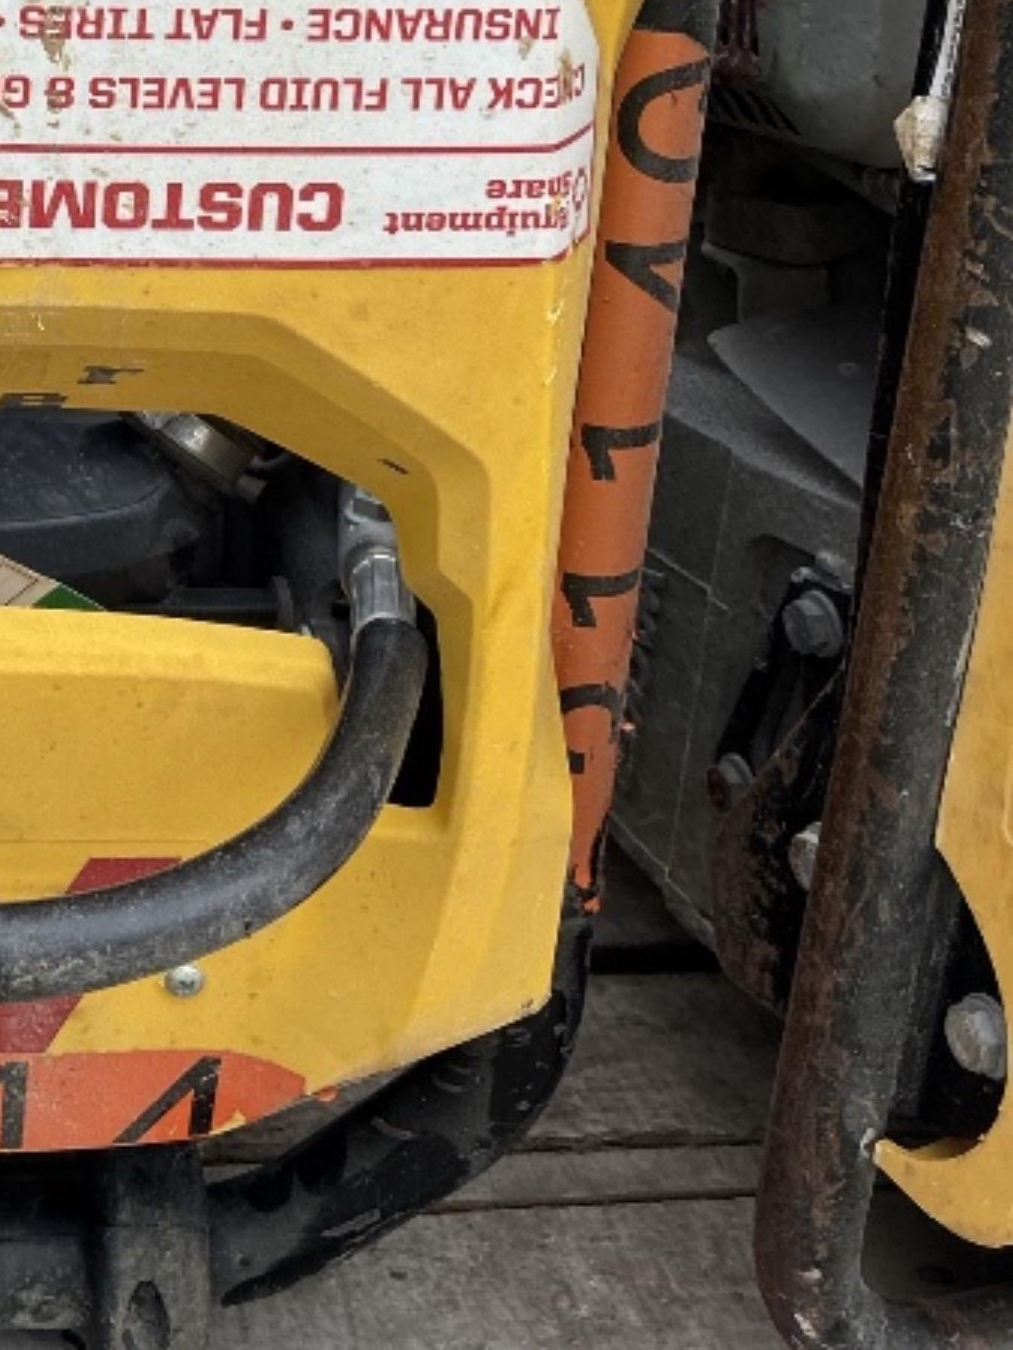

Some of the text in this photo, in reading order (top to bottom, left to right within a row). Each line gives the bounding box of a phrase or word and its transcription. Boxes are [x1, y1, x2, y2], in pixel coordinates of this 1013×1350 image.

[20, 6, 152, 40] TIRES
[169, 8, 266, 41] FLAT
[308, 8, 560, 41] INSURANCE
[44, 75, 74, 109] &
[89, 76, 244, 109] LEVELS
[259, 77, 386, 110] FLUID
[403, 76, 475, 110] ALL
